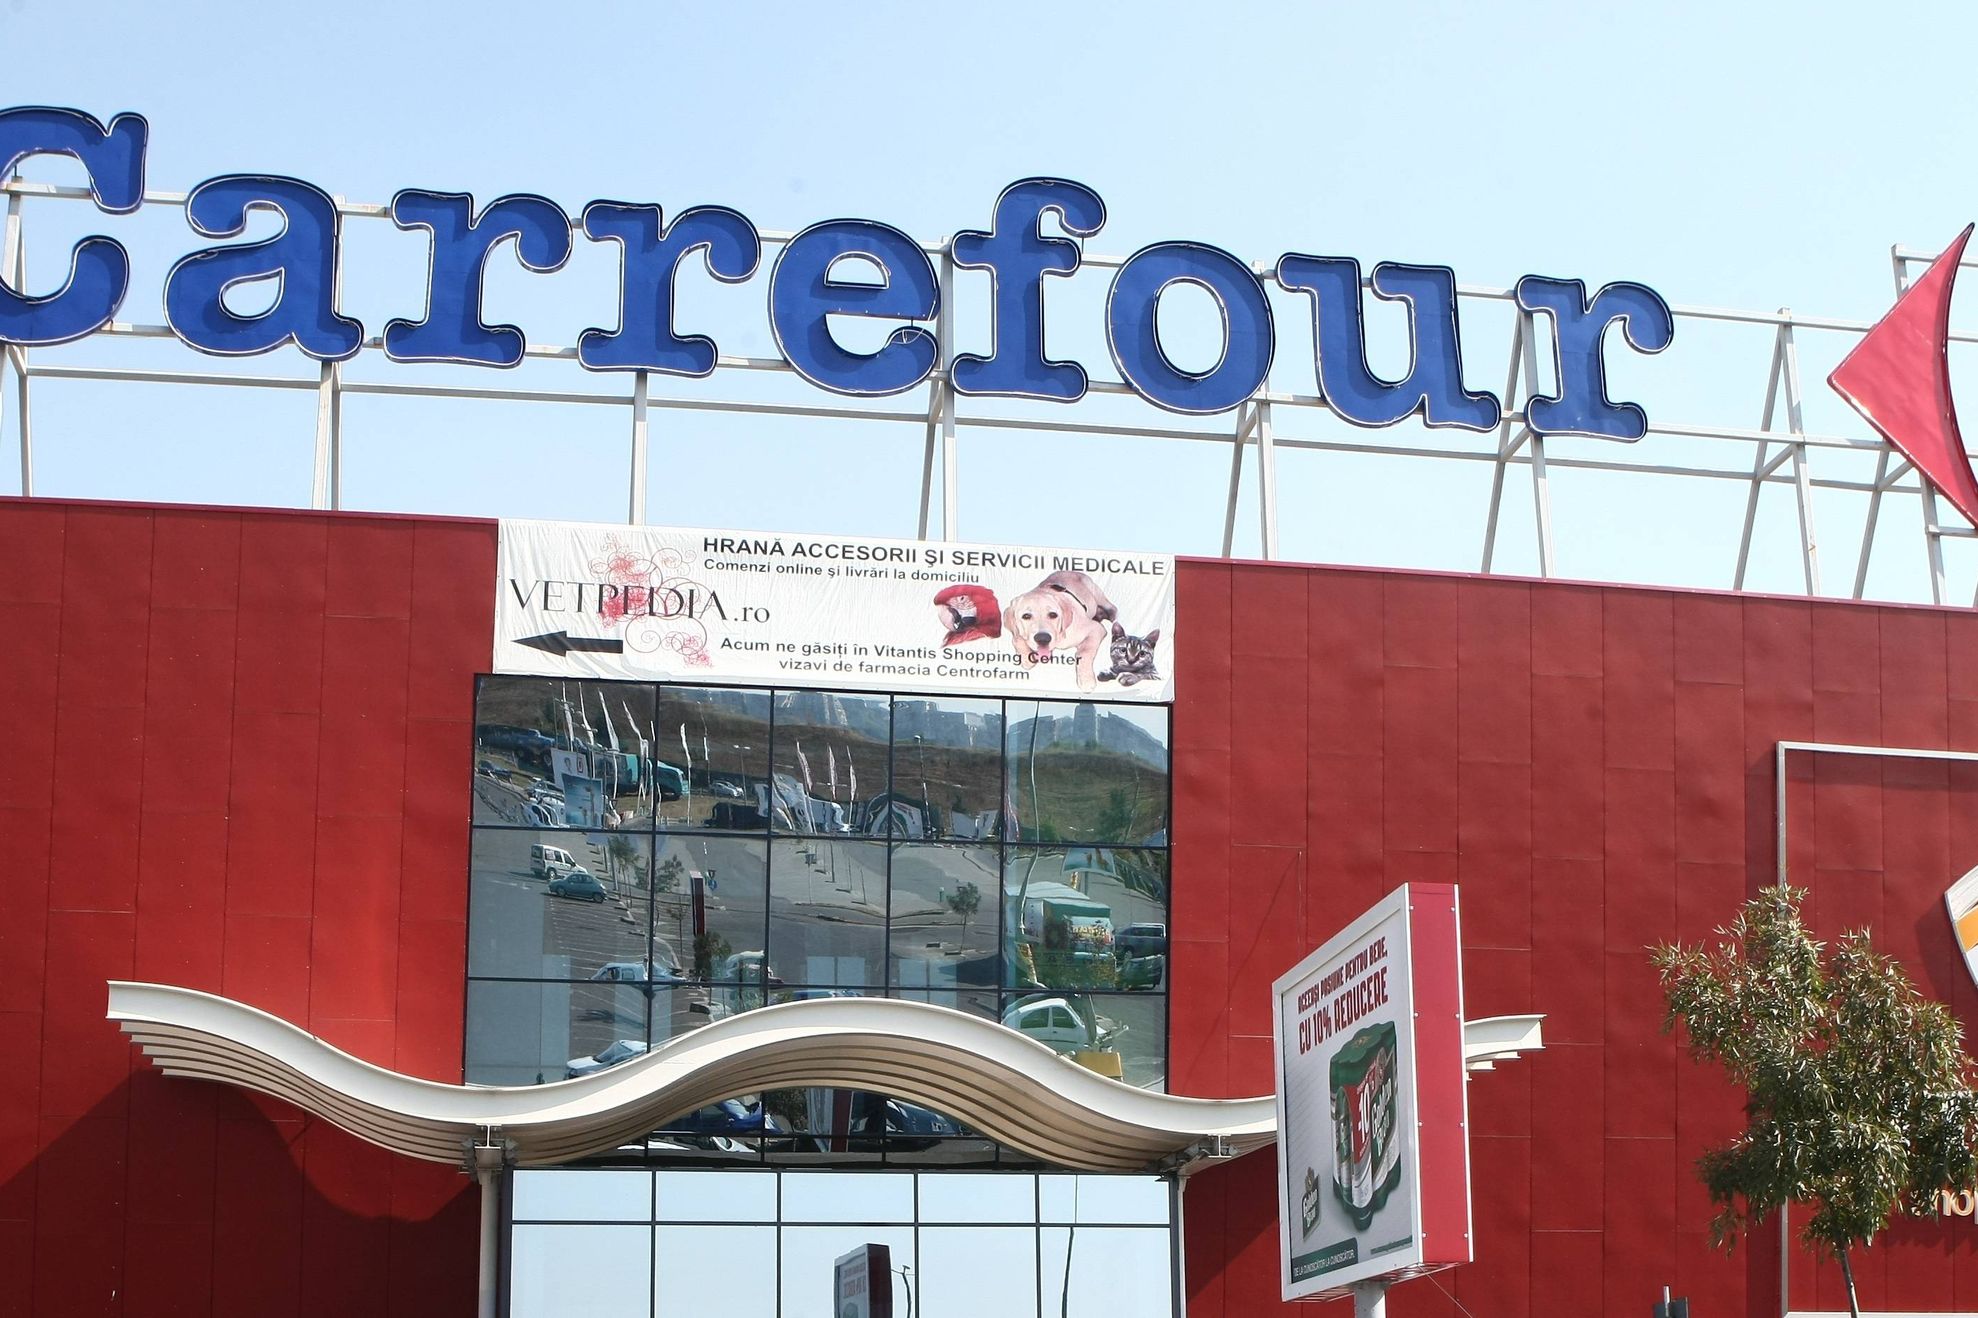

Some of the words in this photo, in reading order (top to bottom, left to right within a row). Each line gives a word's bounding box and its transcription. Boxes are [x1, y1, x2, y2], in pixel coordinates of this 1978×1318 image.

[0, 105, 1673, 442] Carrefour
[702, 536, 785, 557] HRANĂ
[791, 540, 917, 563] ACCESORII
[952, 550, 1045, 570] SERVICII
[1053, 555, 1165, 576] MEDICALE
[703, 558, 771, 574] Comenzi
[776, 561, 823, 576] online
[845, 565, 889, 580] livrări
[893, 567, 906, 580] la
[911, 567, 979, 583] domiciliu
[720, 637, 770, 652] Acum
[776, 641, 796, 653] ne
[853, 643, 868, 657] în
[874, 645, 936, 660] Vitantis
[943, 648, 1022, 666] Shopping
[1028, 652, 1082, 666] Center
[779, 657, 827, 672] vizavi
[833, 660, 853, 674] de
[859, 661, 931, 676] farmacia
[937, 664, 1030, 681] Centrofarm
[1299, 1016, 1311, 1055] CU
[1313, 1004, 1332, 1047] 10%
[1333, 966, 1388, 1034] REDUCERE
